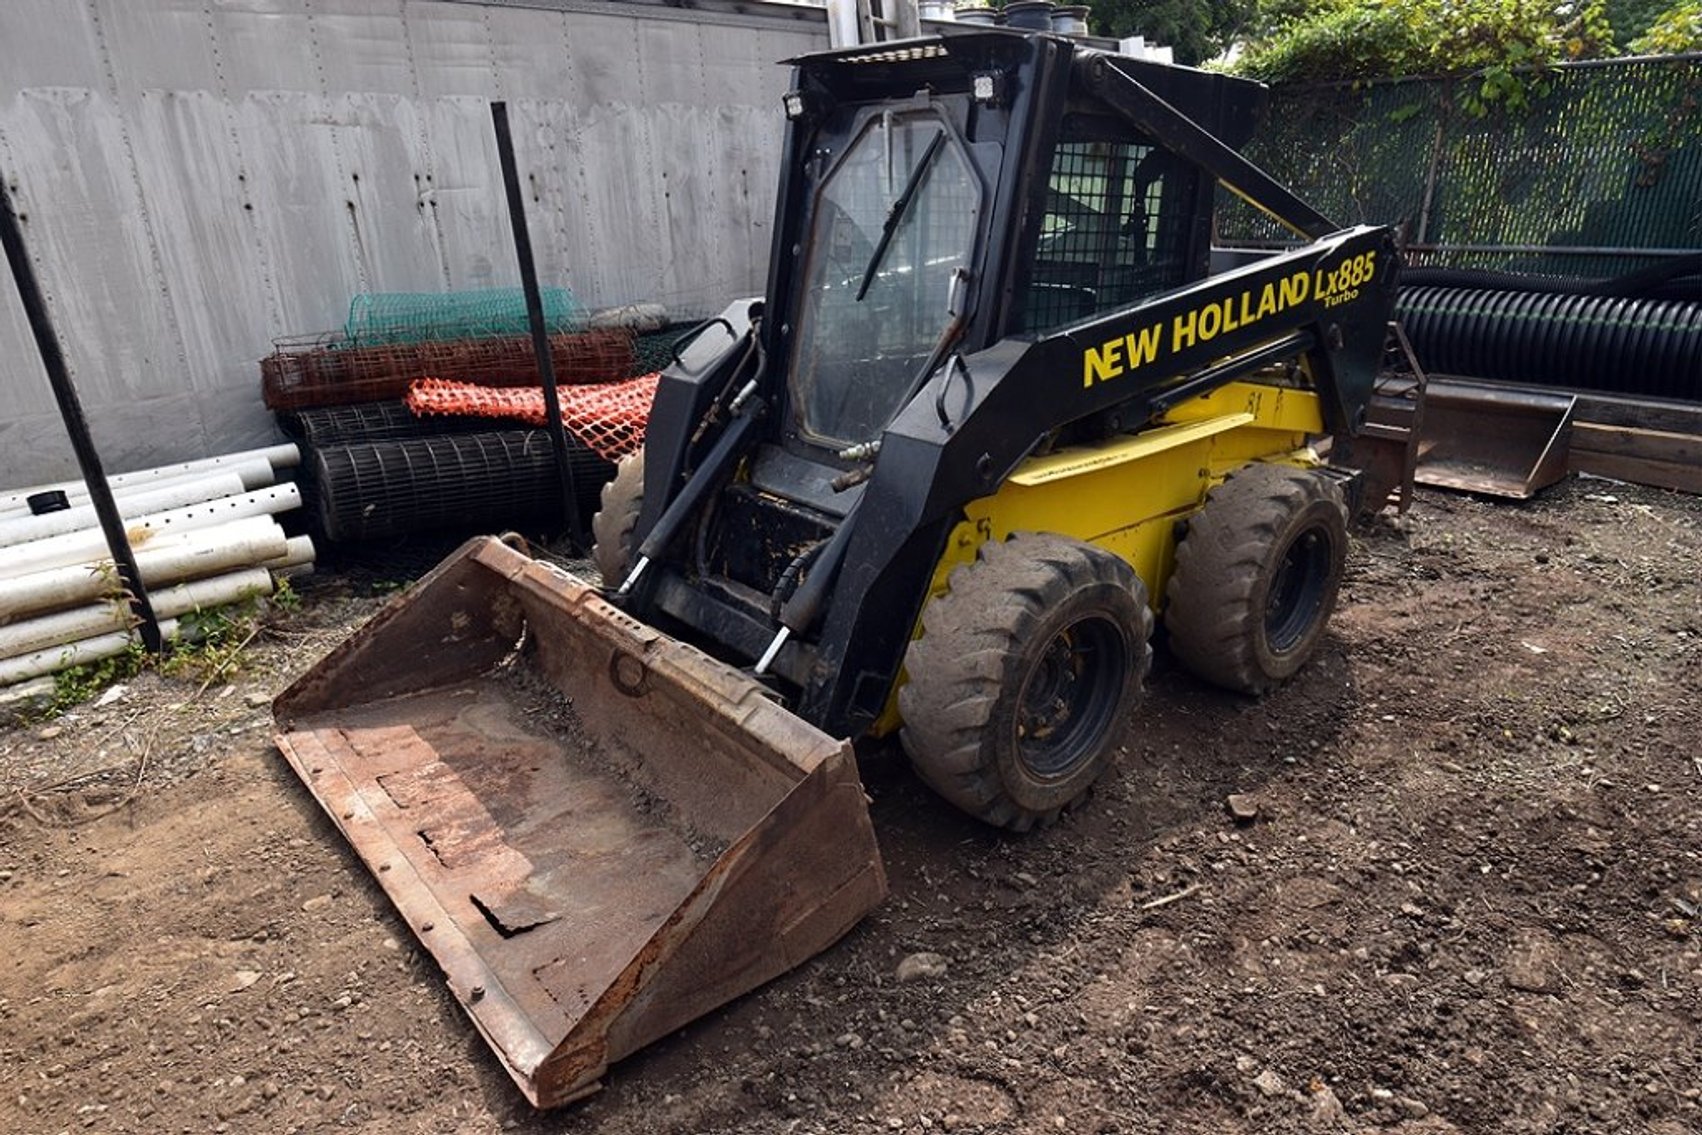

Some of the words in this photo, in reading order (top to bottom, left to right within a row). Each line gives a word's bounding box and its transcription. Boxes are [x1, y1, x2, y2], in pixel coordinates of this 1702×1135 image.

[1083, 322, 1163, 388] NEW
[1172, 271, 1310, 352] HOLLAND
[1324, 289, 1359, 308] Turbo
